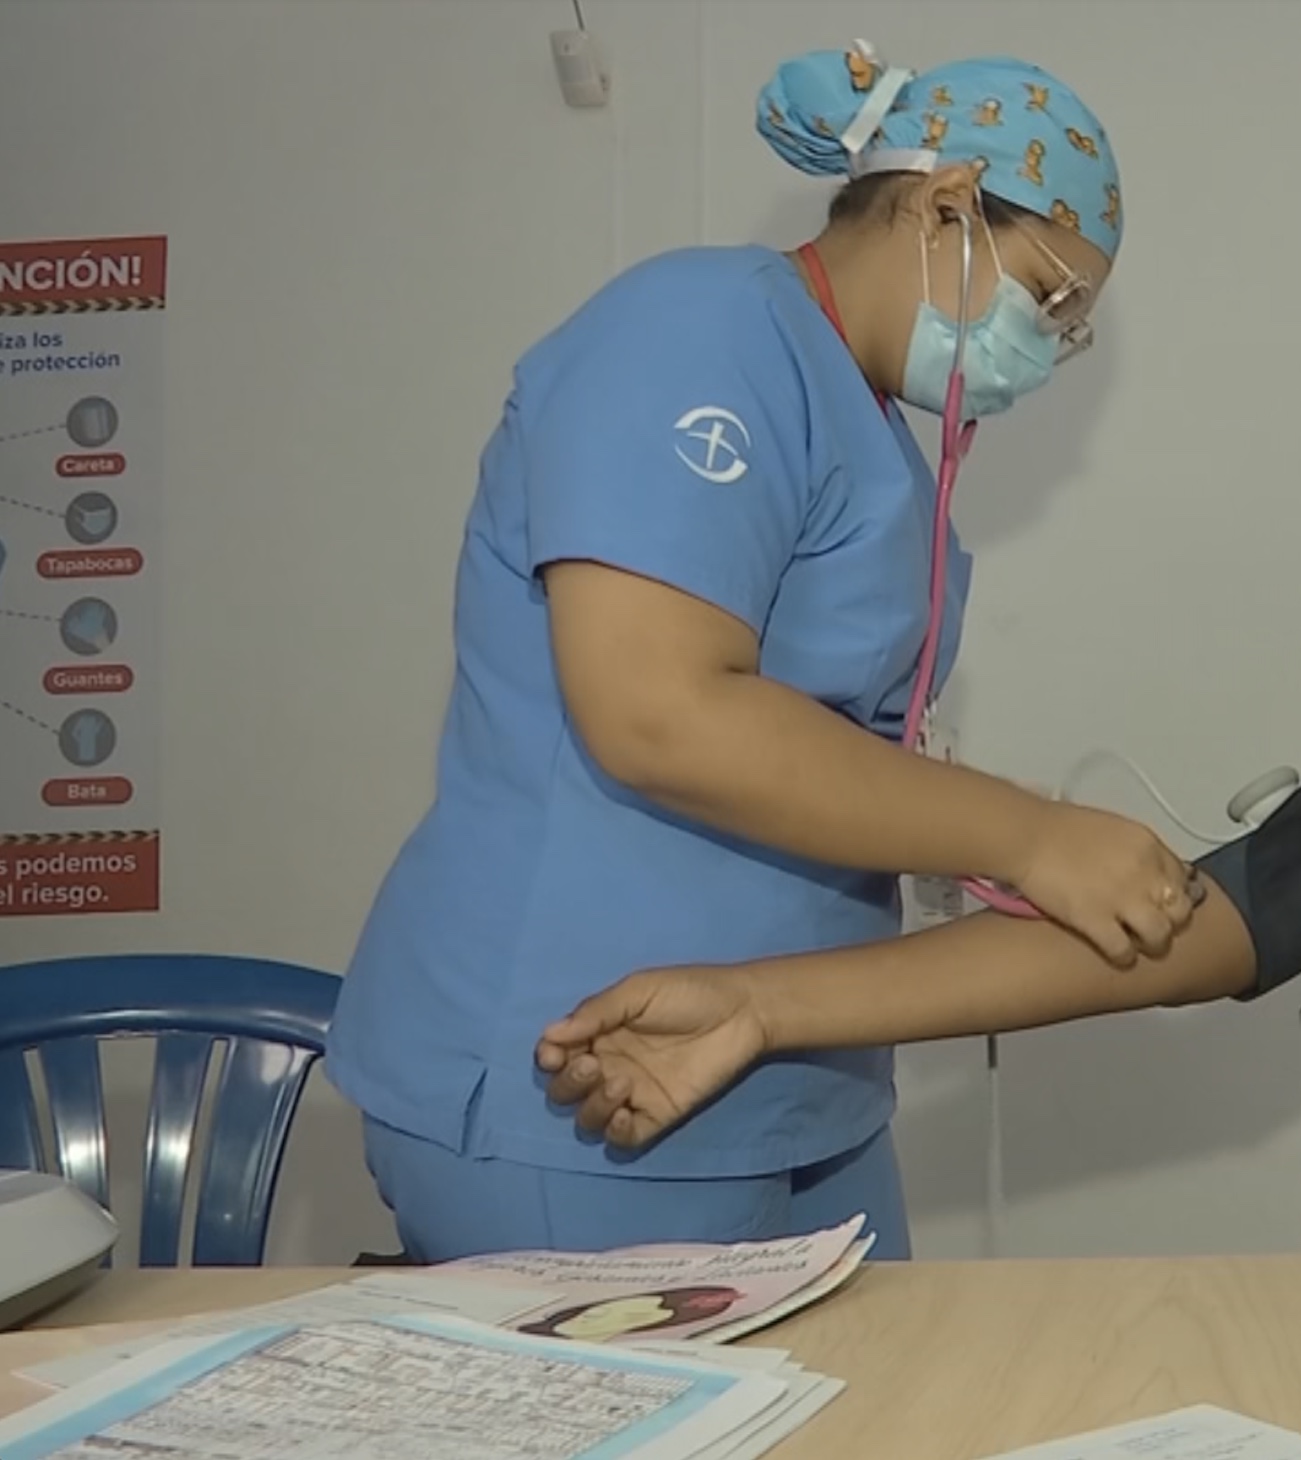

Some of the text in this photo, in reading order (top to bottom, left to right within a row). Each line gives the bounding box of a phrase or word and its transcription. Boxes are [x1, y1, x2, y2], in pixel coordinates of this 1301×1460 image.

[33, 331, 62, 348] los
[11, 351, 121, 375] protección
[62, 457, 114, 473] Careta
[47, 555, 133, 574] Tapabocas
[53, 671, 123, 688] Guantes
[67, 784, 106, 799] Bata
[15, 852, 137, 880] podemos
[22, 882, 109, 907] riesgo.
